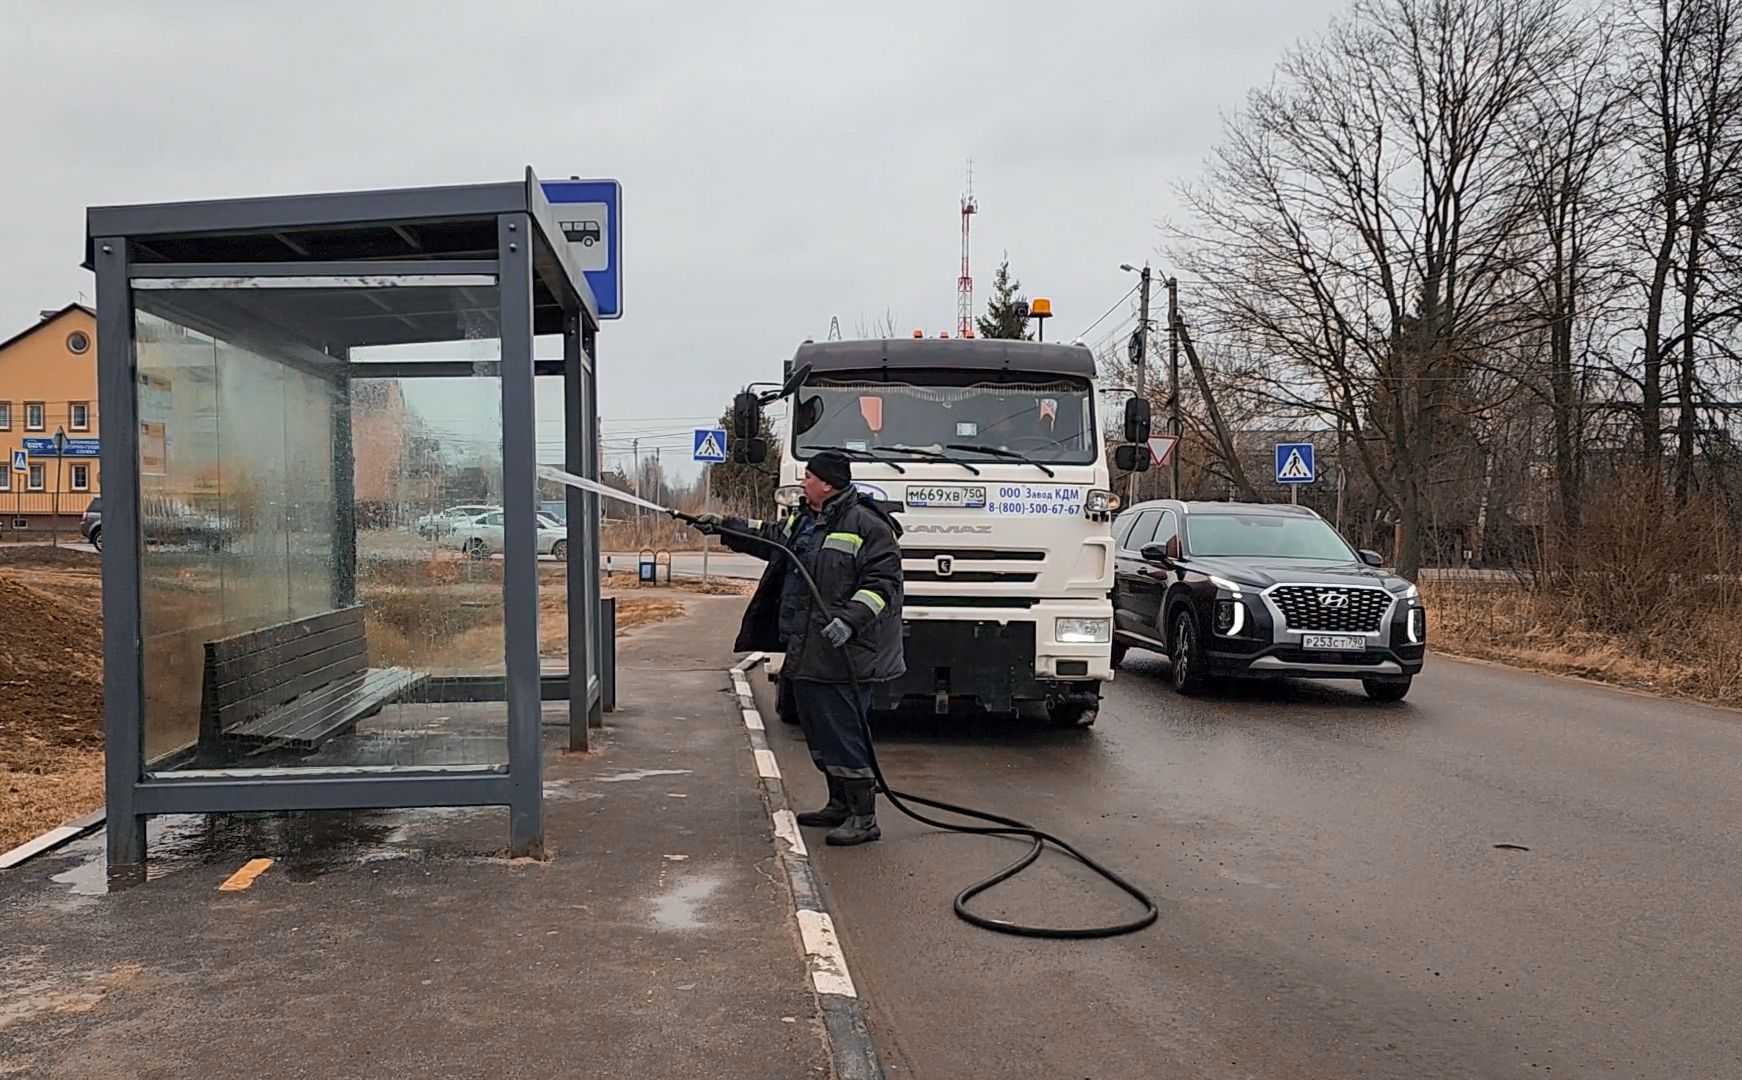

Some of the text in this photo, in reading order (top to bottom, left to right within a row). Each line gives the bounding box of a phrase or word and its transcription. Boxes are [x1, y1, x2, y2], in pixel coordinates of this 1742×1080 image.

[999, 487, 1079, 501] ООО Завод КДМ
[988, 502, 1081, 514] 8-(800)-500-67-67
